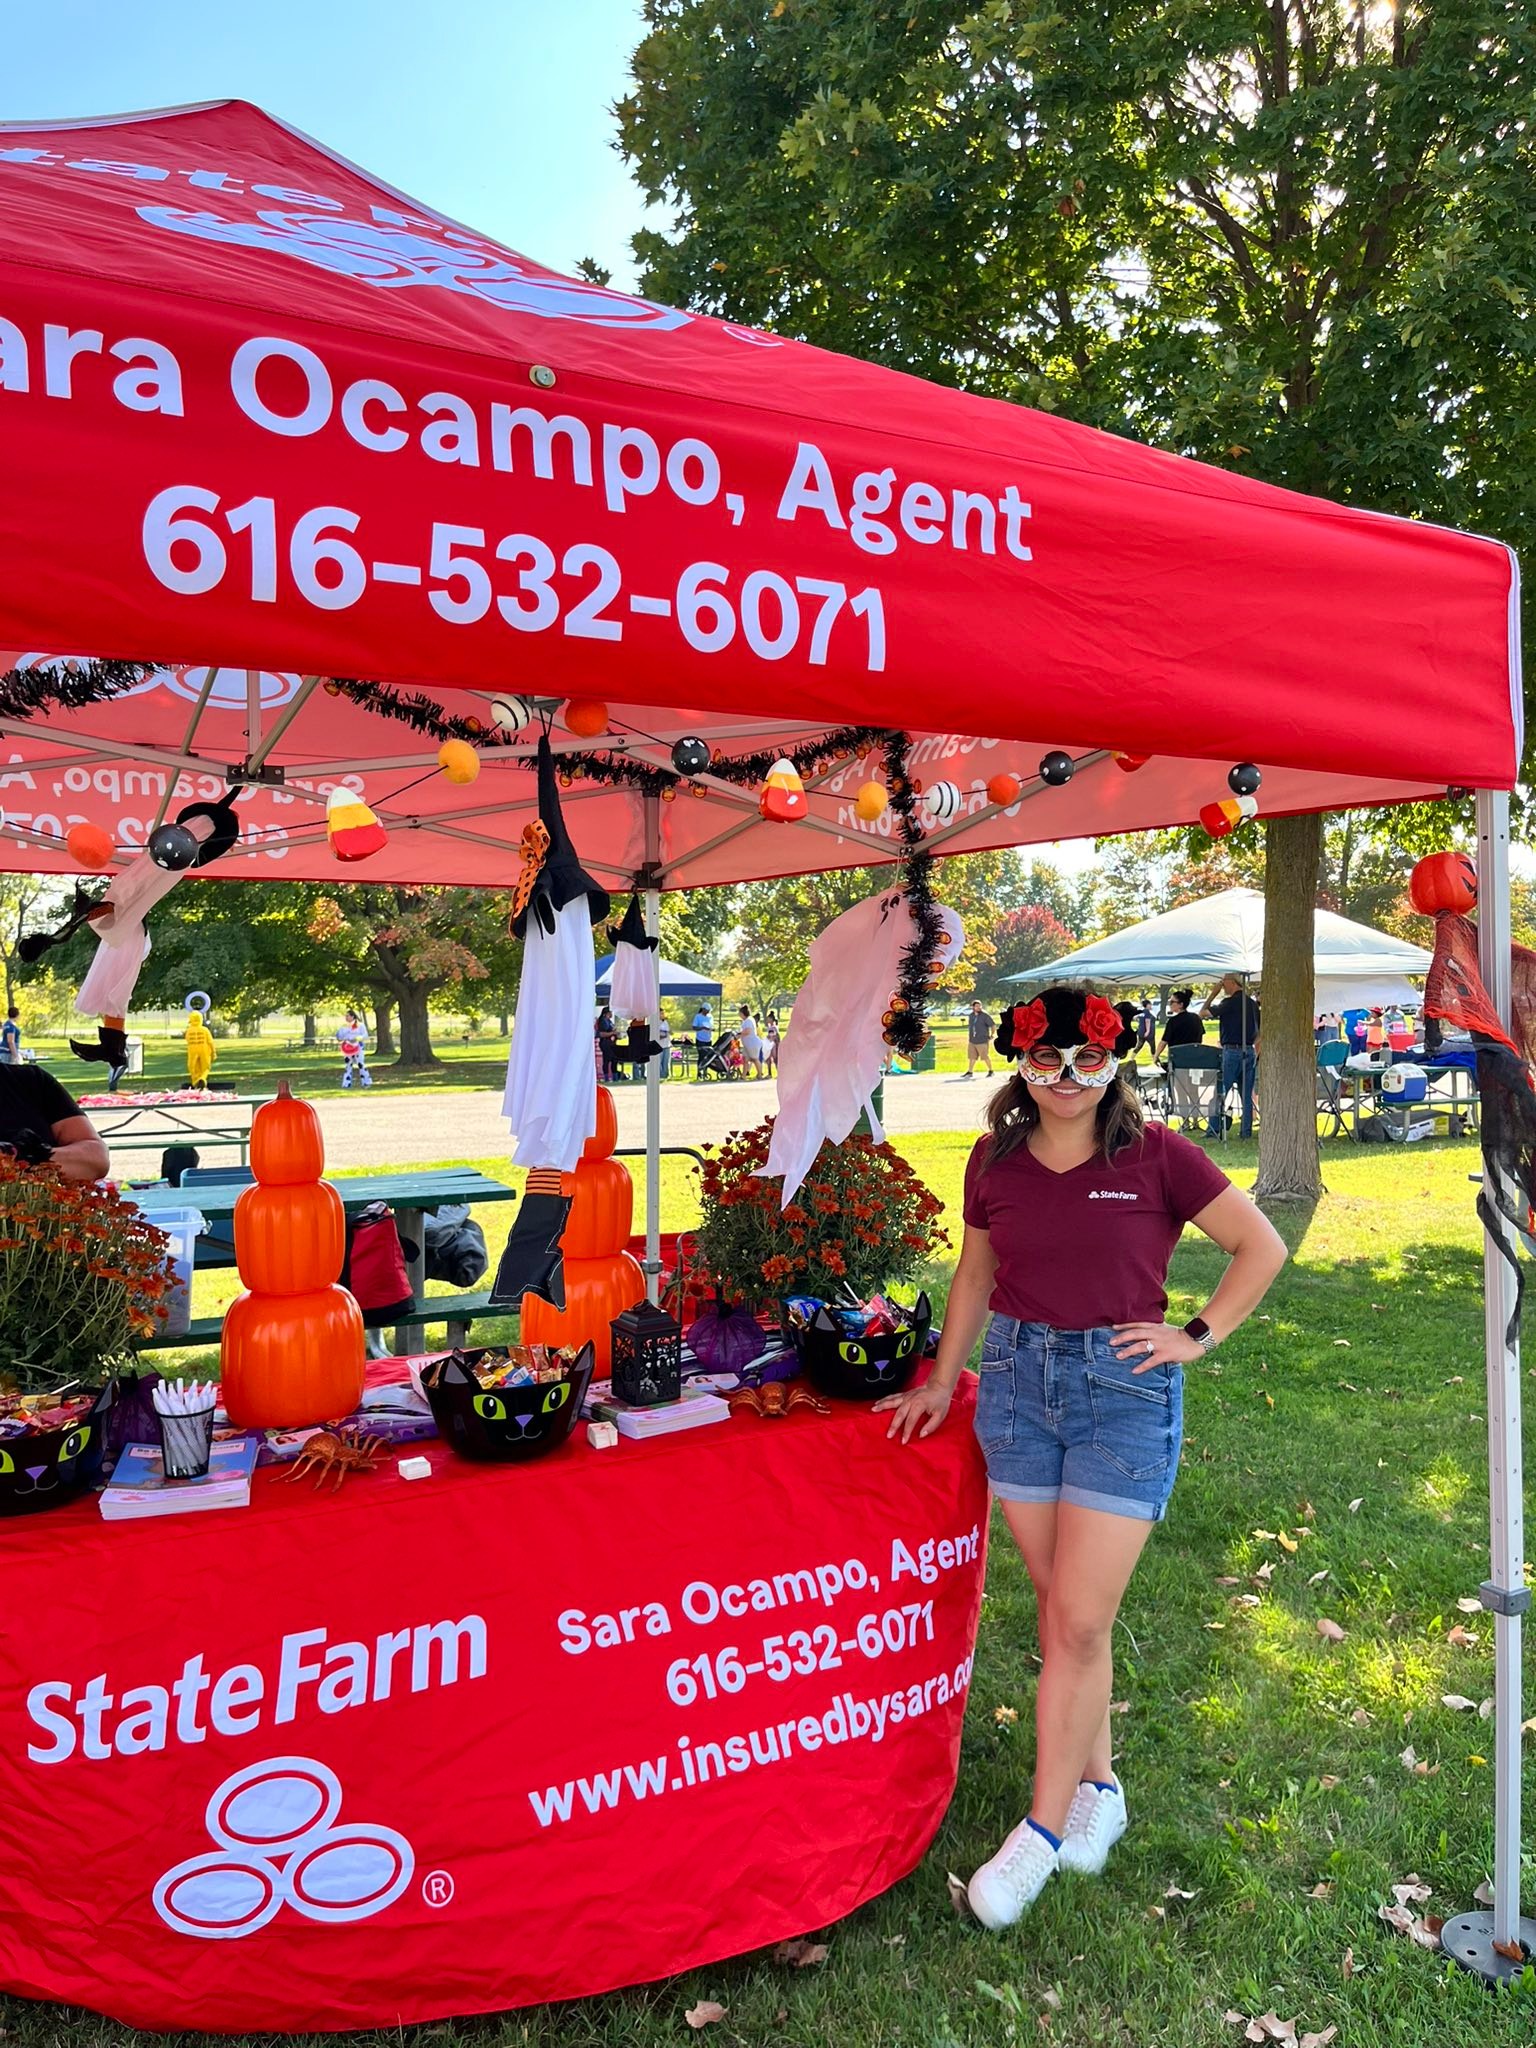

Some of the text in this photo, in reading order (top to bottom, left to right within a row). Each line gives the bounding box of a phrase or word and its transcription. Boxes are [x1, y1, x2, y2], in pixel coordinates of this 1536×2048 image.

[230, 336, 746, 526] Ocampo,
[776, 441, 1033, 562] Agent
[142, 484, 887, 673] 616-532-6071
[556, 1524, 979, 1656] Sara Ocampo, Agent
[665, 1599, 936, 1707] 616-532-6071
[528, 1648, 975, 1828] www.insuredbysara.co
